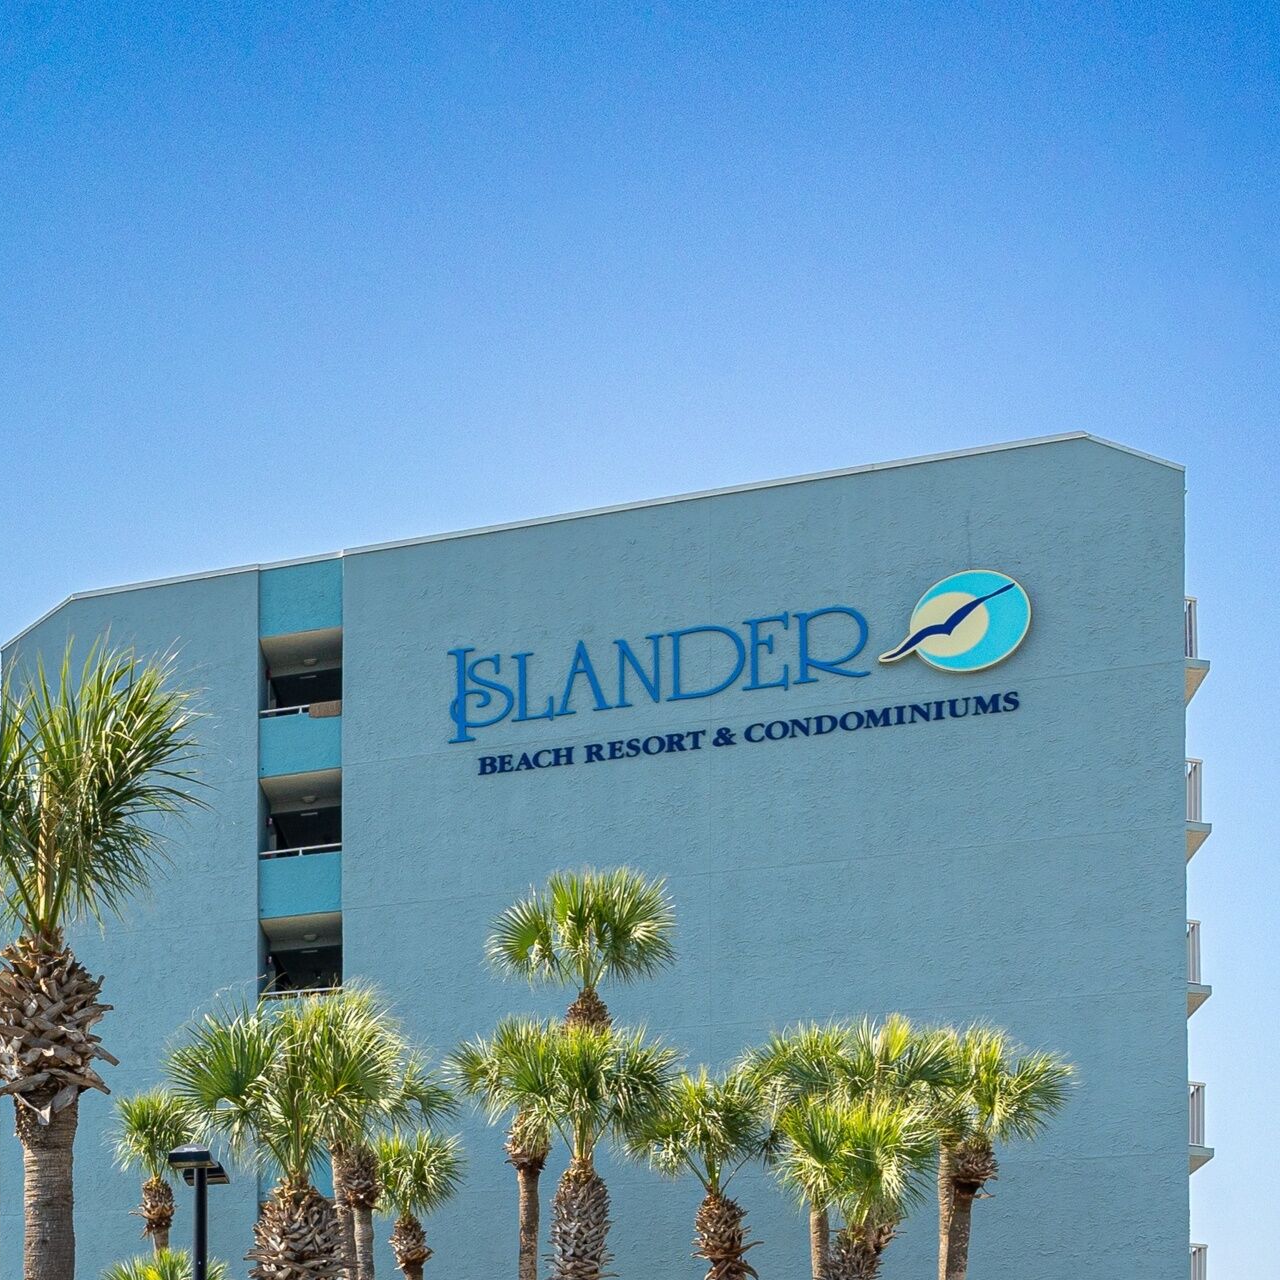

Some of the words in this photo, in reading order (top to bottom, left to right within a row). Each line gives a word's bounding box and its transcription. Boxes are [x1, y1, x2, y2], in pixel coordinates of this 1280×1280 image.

[447, 604, 871, 744] ISLANDER
[477, 746, 575, 776] BEACH
[584, 729, 706, 765] RESORT
[712, 727, 738, 747] &
[743, 691, 1020, 743] CONDOMINIUMS
